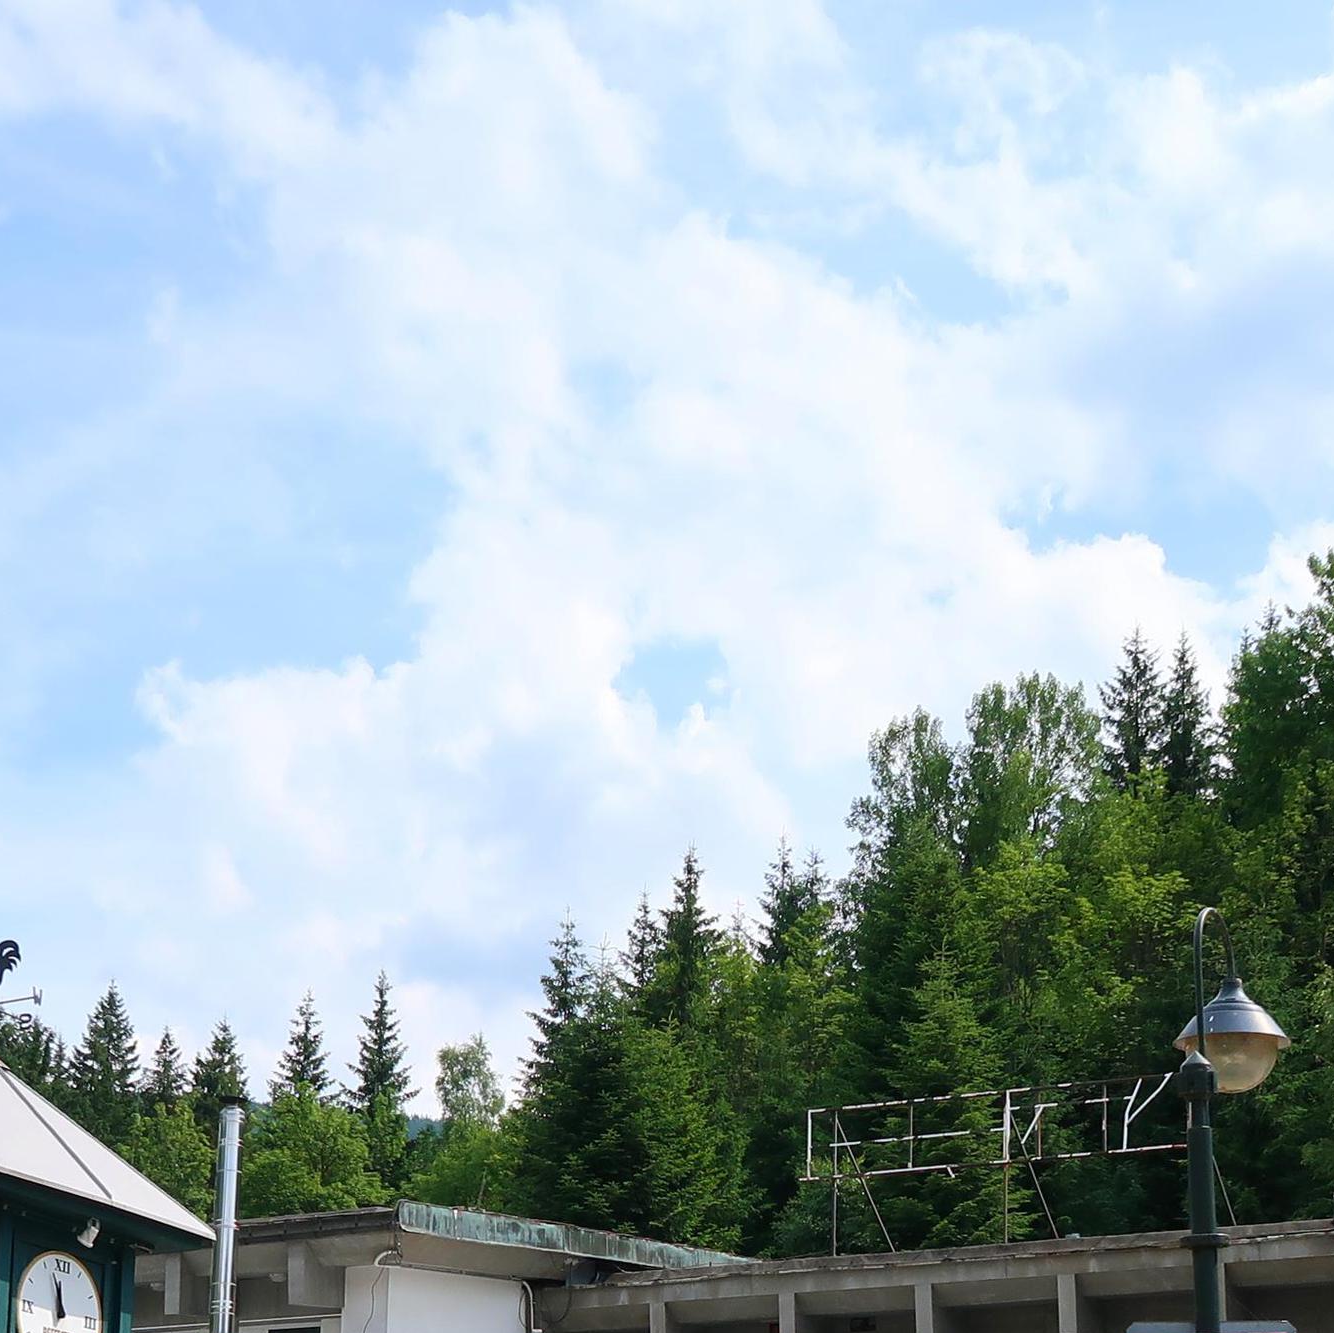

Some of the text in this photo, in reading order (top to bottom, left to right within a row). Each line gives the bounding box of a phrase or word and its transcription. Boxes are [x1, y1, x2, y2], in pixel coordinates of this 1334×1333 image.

[55, 1259, 71, 1274] XII
[22, 1299, 97, 1330] IX III
